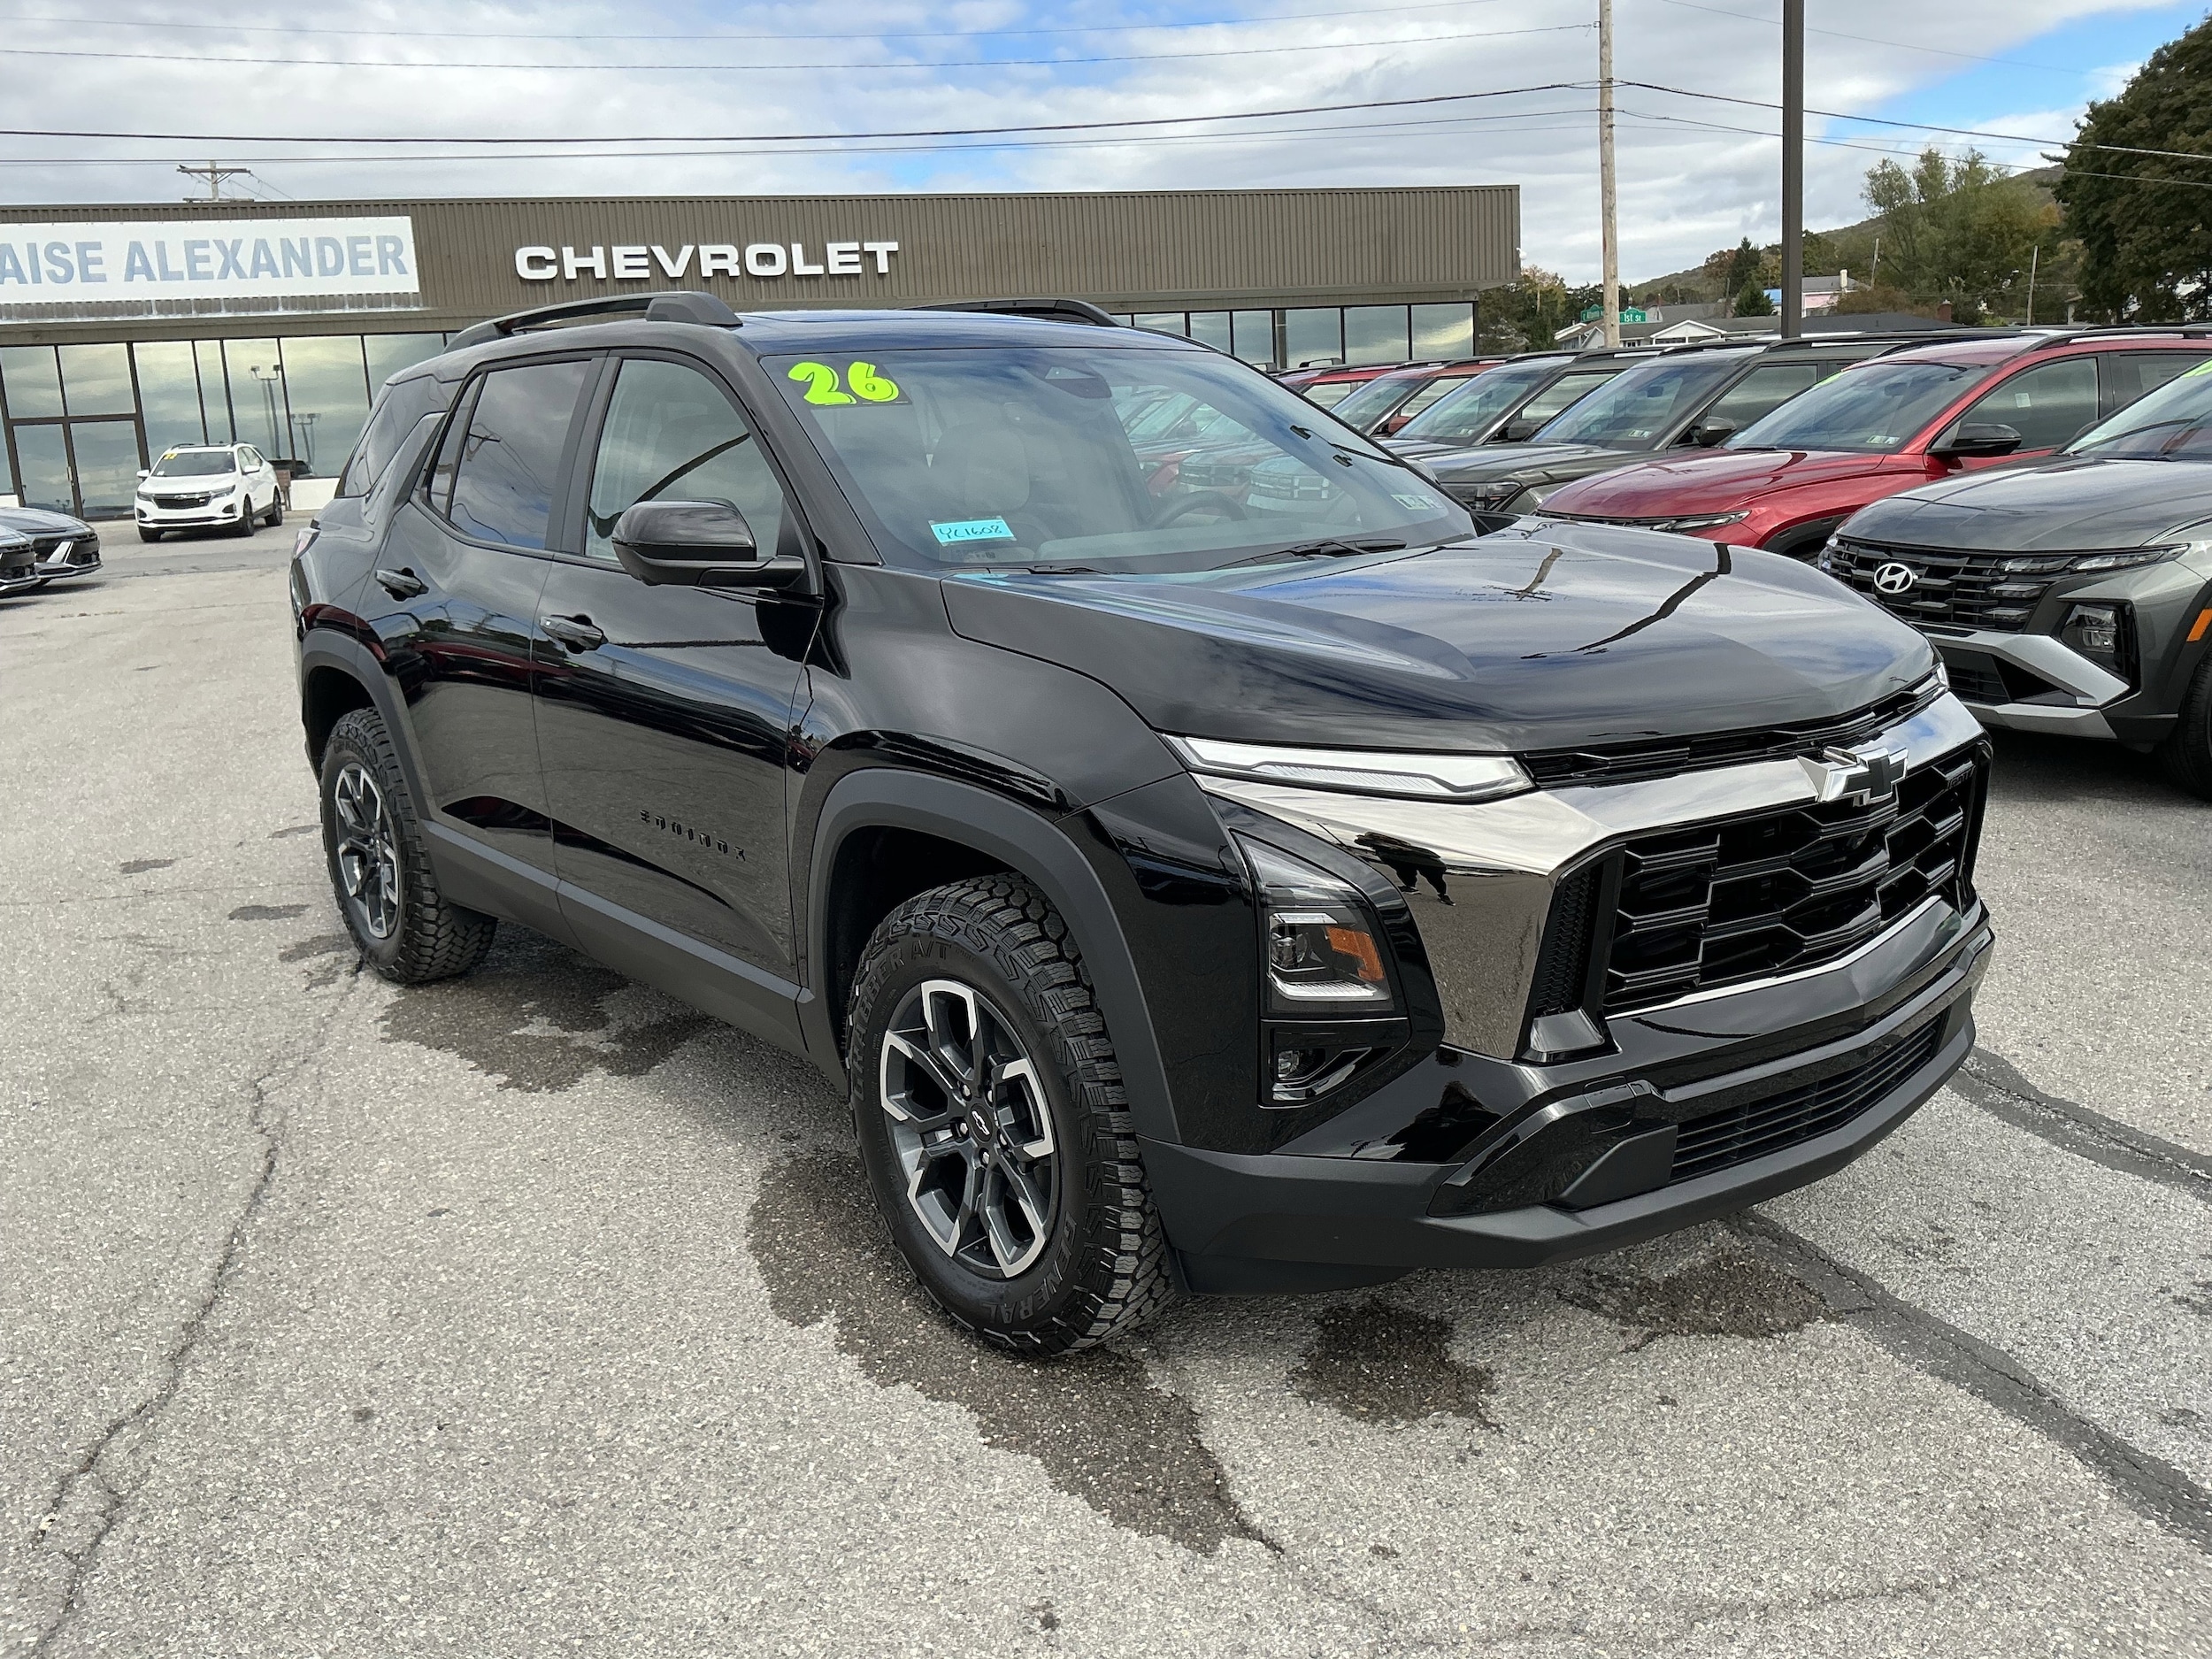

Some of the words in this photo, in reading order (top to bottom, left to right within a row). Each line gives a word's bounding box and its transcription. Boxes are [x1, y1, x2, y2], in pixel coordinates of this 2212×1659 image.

[0, 241, 108, 285] AISE
[124, 234, 410, 282] ALEXANDER
[514, 241, 899, 281] CHEVROLET
[787, 361, 901, 406] 26
[979, 1210, 1078, 1325] GENERAL
